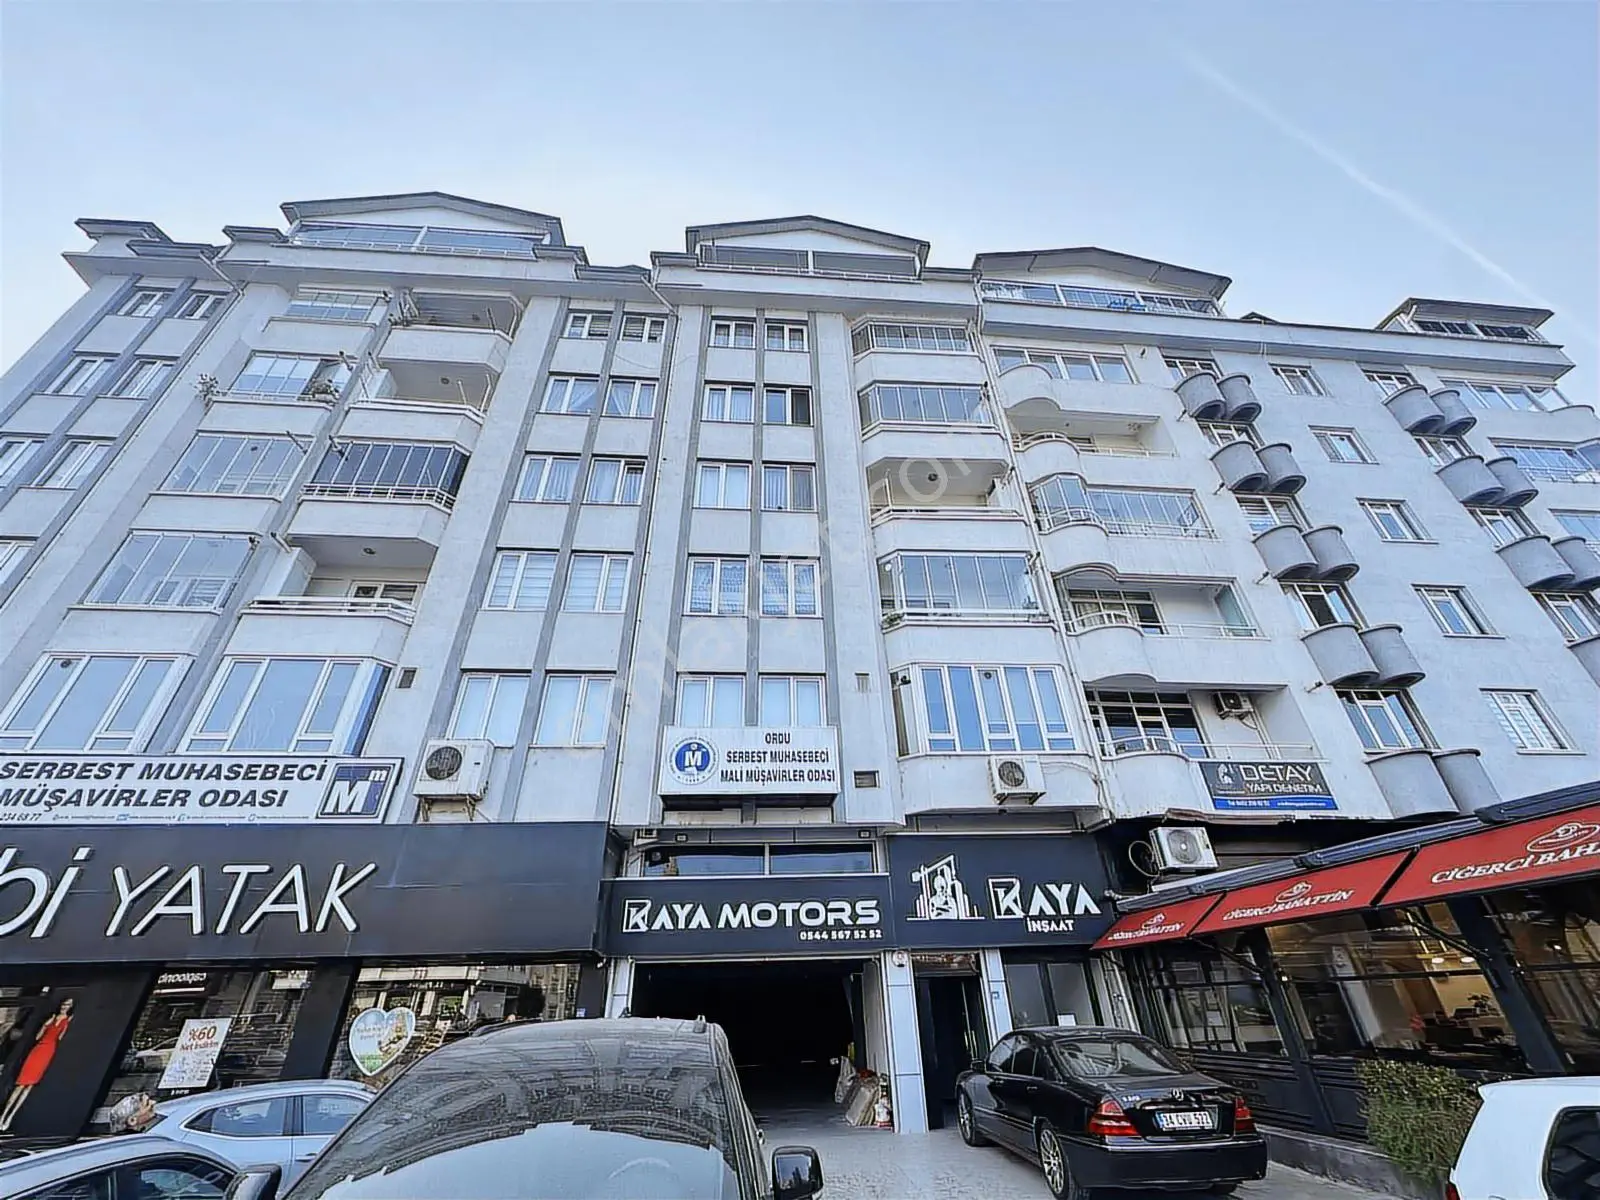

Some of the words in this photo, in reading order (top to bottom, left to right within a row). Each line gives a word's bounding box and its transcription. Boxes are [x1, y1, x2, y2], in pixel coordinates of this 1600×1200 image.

[764, 731, 791, 745] ORDU
[726, 750, 768, 763] SERBEST
[770, 747, 830, 763] MUHASEBECİ
[0, 761, 136, 780] SERBEST
[137, 759, 328, 781] MUHASEBECİ
[720, 765, 743, 783] MALİ
[745, 766, 805, 786] MÜŞAVİRLER
[807, 769, 835, 783] ODASI
[1239, 764, 1312, 781] DETAY
[0, 783, 192, 812] MÜŞAVİRLER
[198, 788, 289, 808] ODASI
[1533, 842, 1600, 866] BAH
[104, 862, 376, 937] YATAK
[988, 878, 1102, 919] KAYA
[623, 899, 711, 932] KAYA
[717, 900, 880, 928] MOTORS
[1027, 916, 1074, 933] İNŞAAT
[799, 931, 829, 940] 0544
[830, 930, 851, 940] 567
[853, 929, 867, 939] 52
[868, 929, 882, 939] 52
